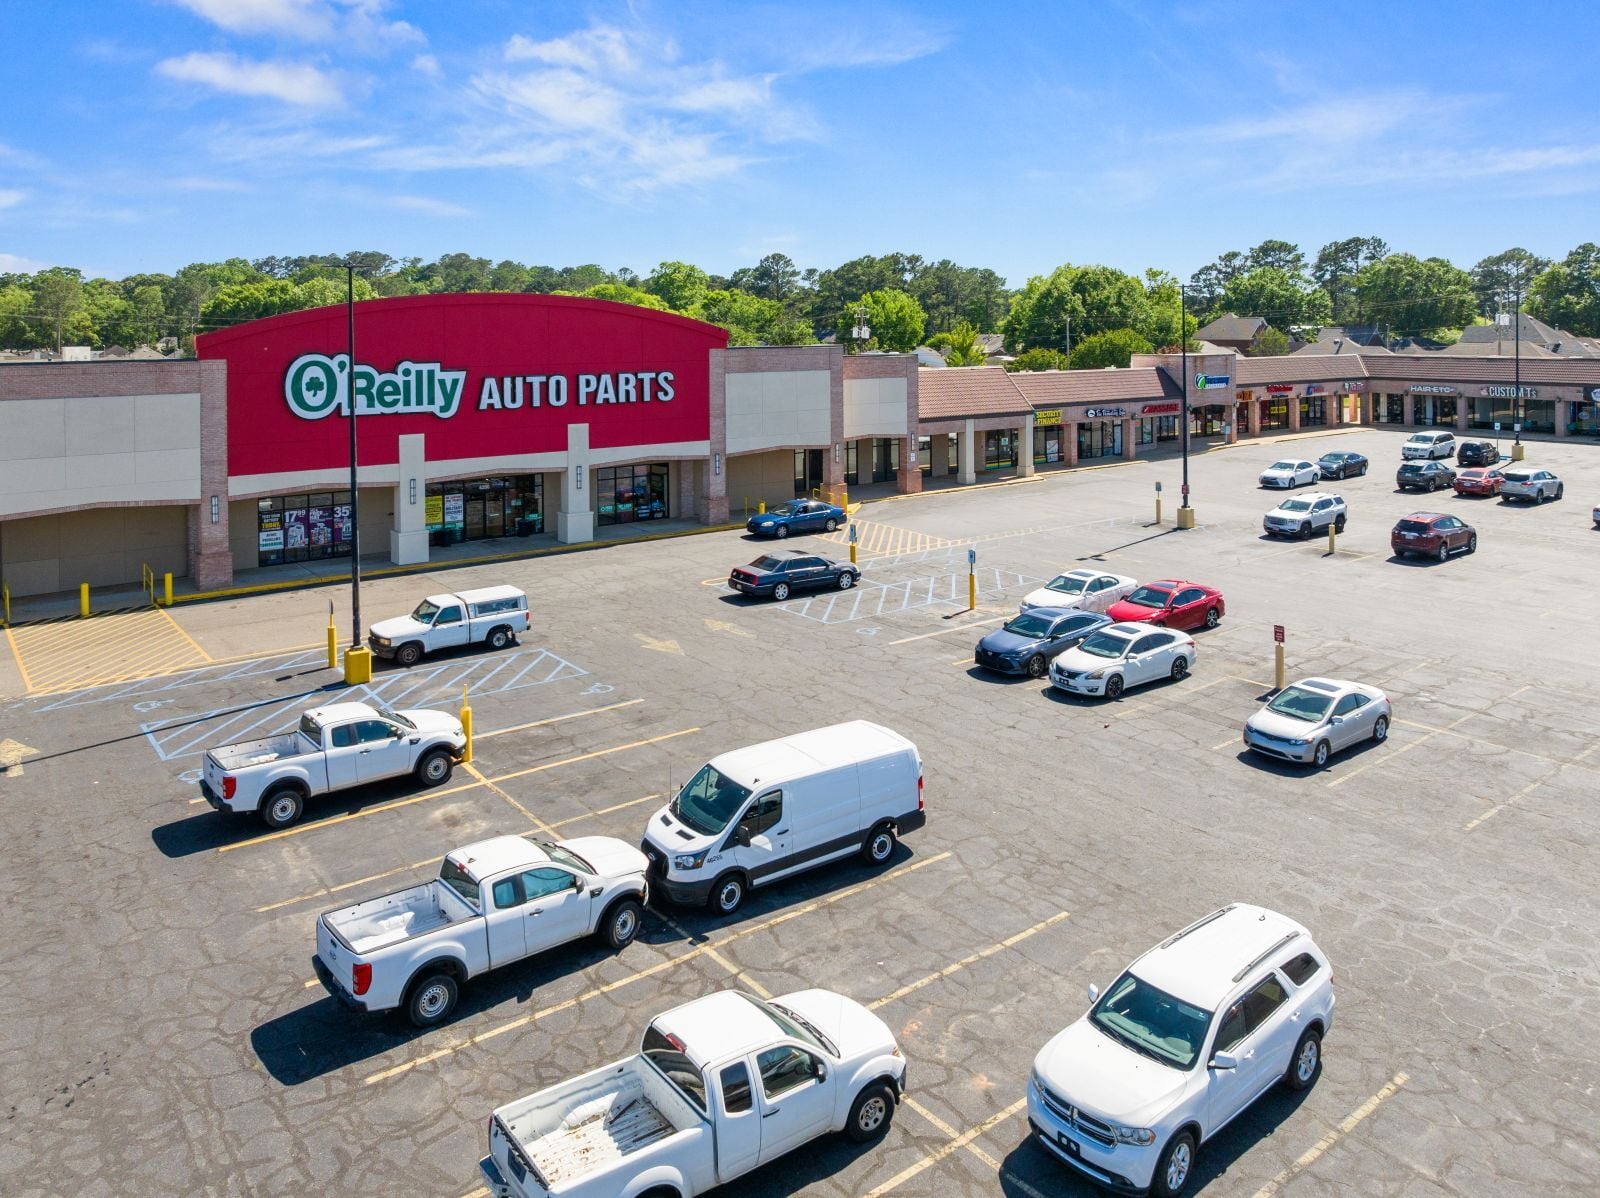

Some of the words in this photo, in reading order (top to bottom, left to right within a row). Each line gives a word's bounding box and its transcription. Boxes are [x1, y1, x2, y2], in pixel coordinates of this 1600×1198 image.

[289, 359, 462, 415] O'Reilly
[478, 375, 568, 410] AUTO
[578, 371, 675, 405] PARTS
[1410, 385, 1431, 393] HAIR
[1489, 386, 1524, 398] CUSTOM
[1036, 410, 1063, 419] SECURITY
[1037, 417, 1063, 425] FINANCE
